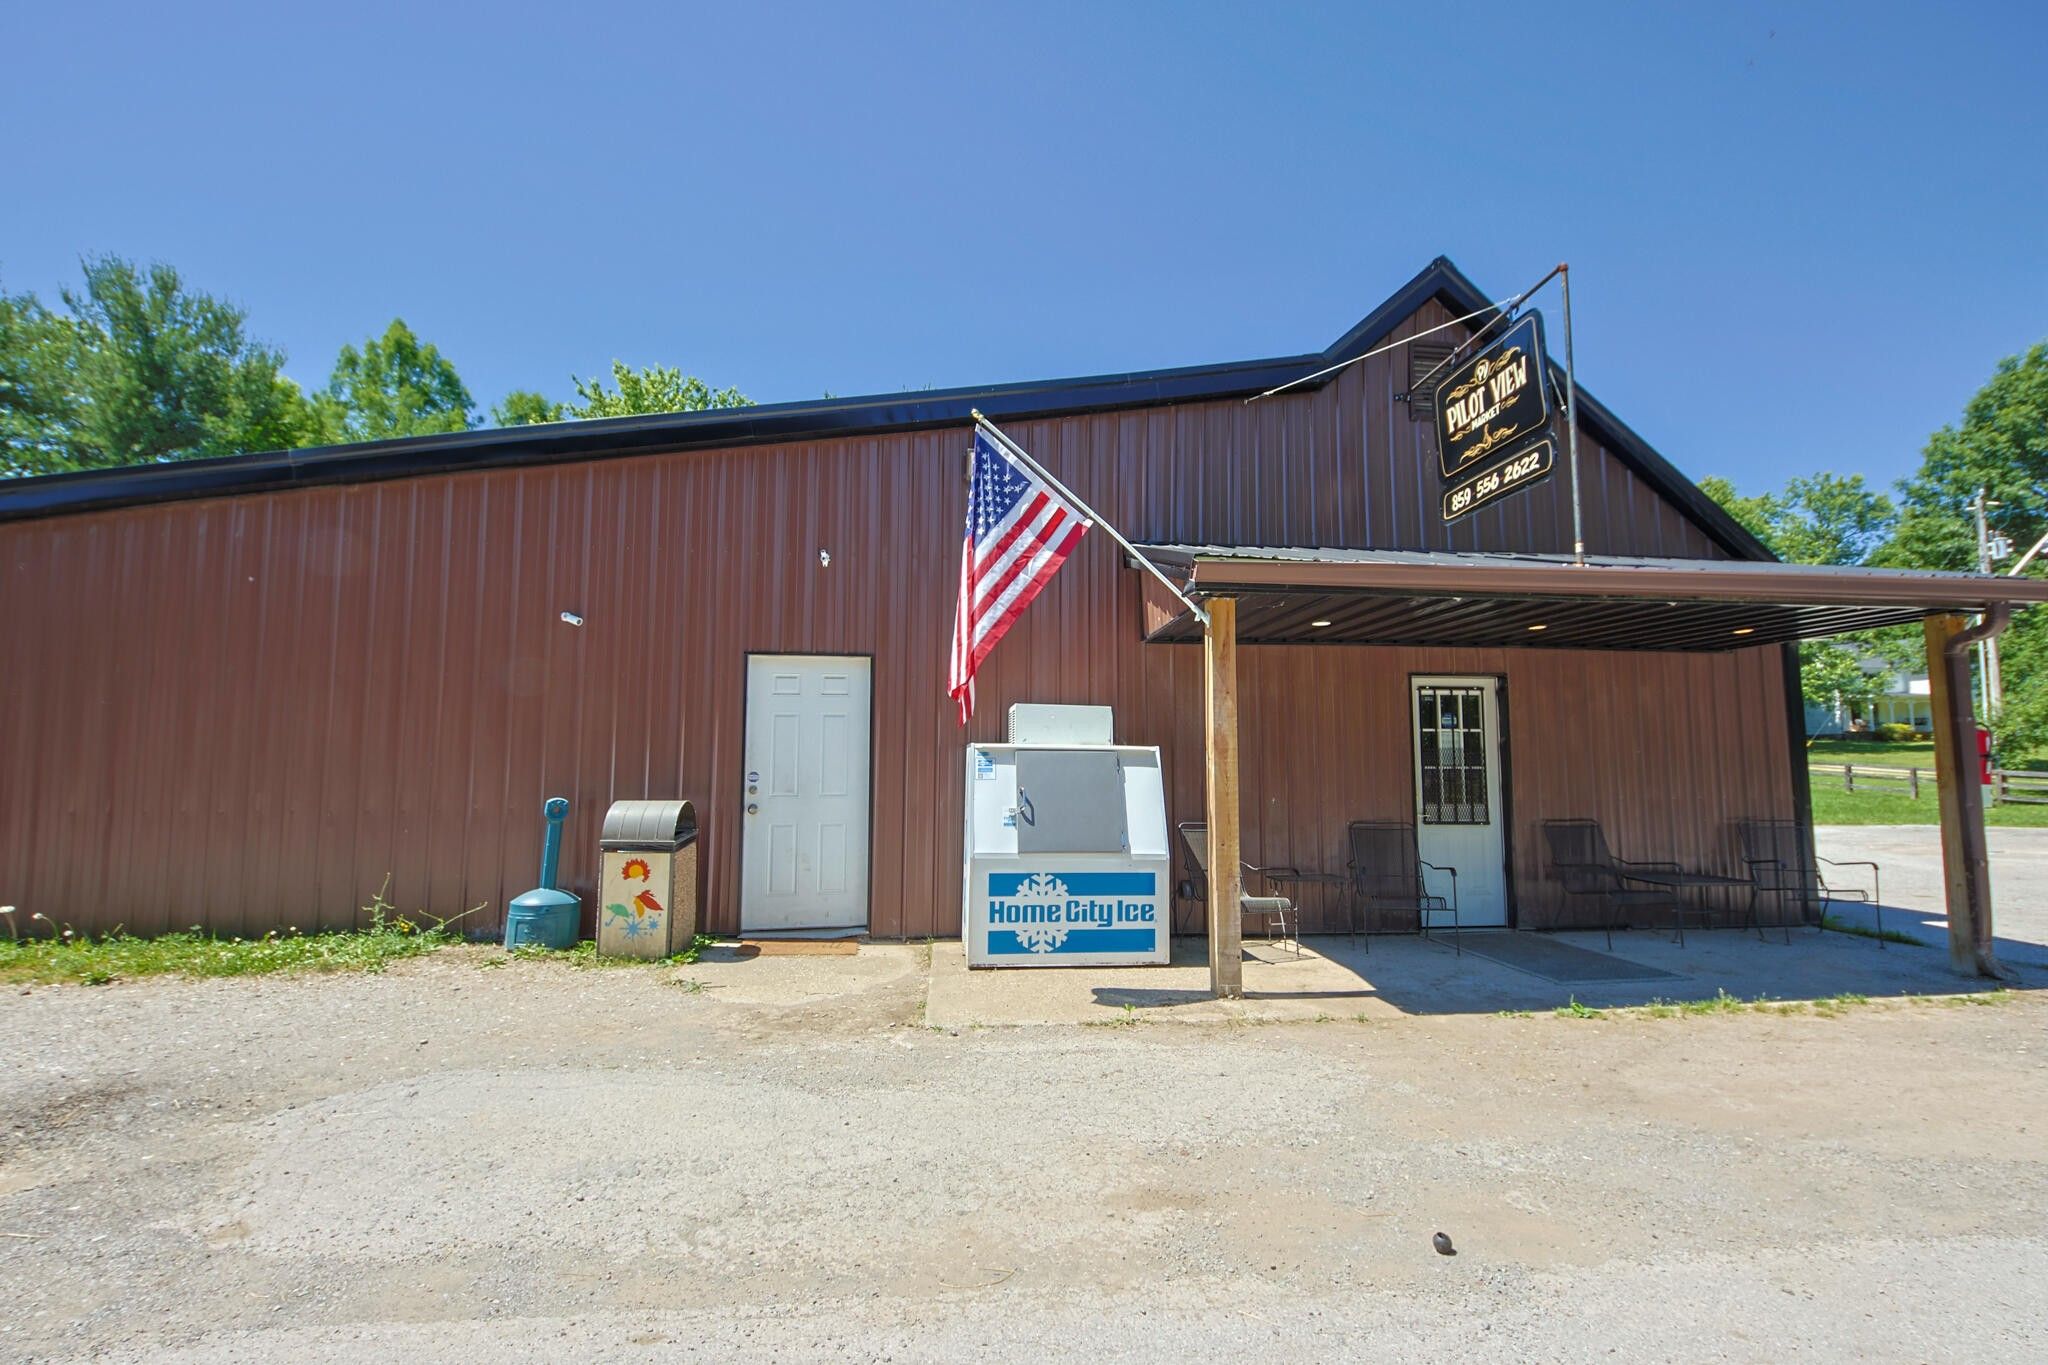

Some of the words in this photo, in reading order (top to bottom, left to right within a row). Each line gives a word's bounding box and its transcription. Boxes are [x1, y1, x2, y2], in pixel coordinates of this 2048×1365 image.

[1446, 386, 1486, 434] PILOT
[1490, 355, 1528, 403] VIEW
[1471, 402, 1501, 431] MARKET
[1451, 487, 1472, 511] 859
[1476, 473, 1500, 498] 556
[1503, 452, 1541, 484] 2622
[989, 900, 1061, 923] Home
[1065, 899, 1113, 928] City
[1117, 899, 1155, 922] Ice
